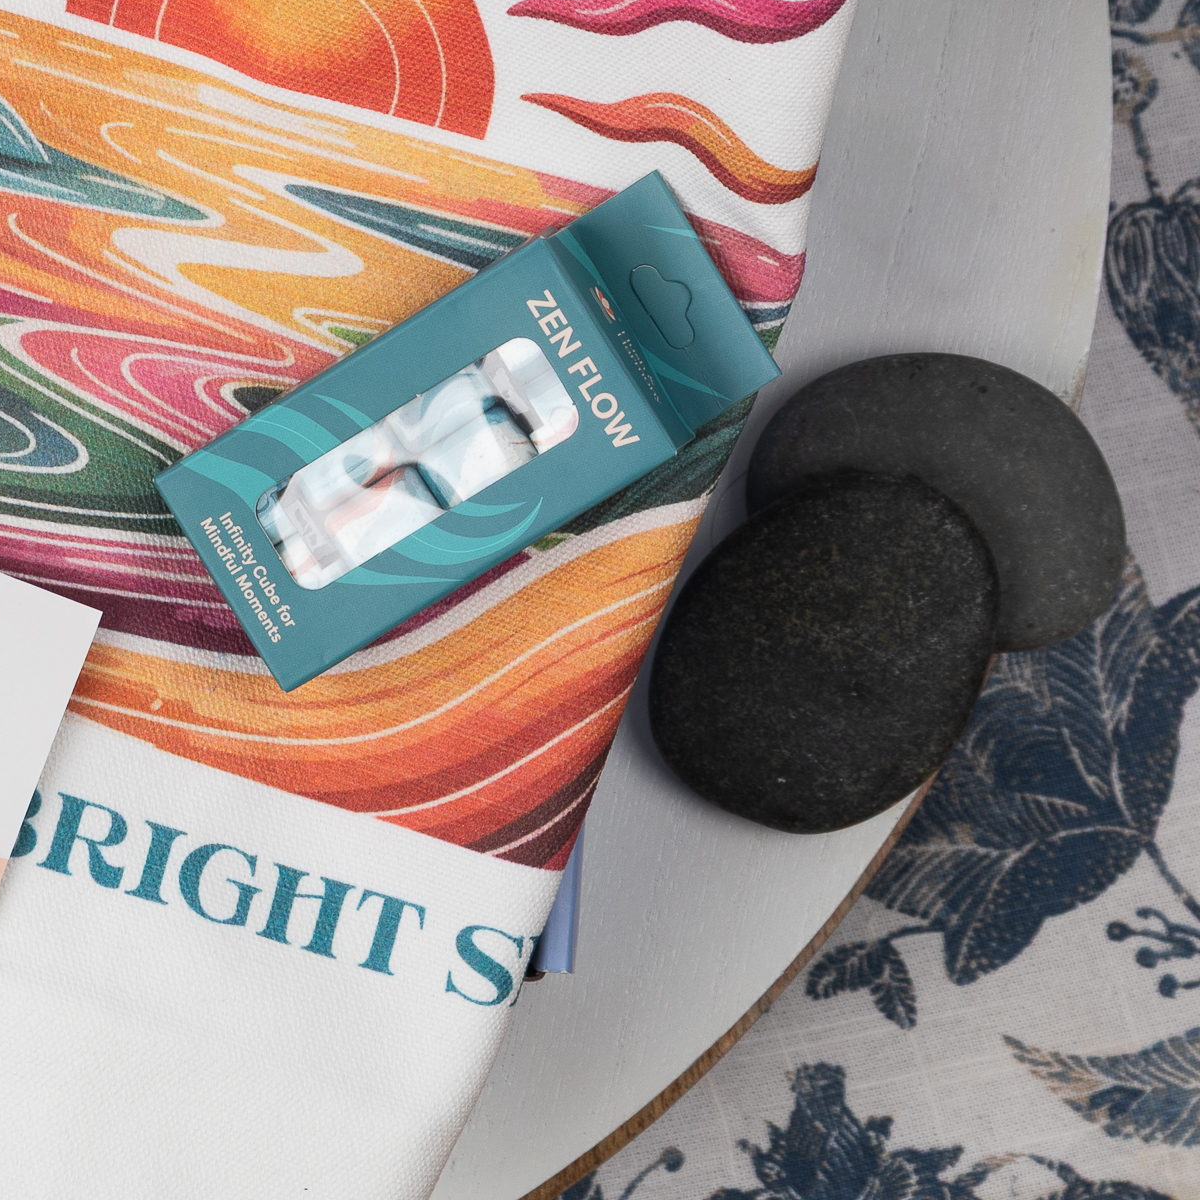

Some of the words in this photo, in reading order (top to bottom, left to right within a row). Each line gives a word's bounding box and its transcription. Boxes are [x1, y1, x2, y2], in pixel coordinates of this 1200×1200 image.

[526, 288, 583, 359] ZEN
[567, 356, 641, 448] FLOW
[200, 517, 243, 576] Mindful
[235, 573, 282, 643] Moments
[219, 511, 257, 566] Infinity
[253, 565, 280, 605] Cube
[276, 604, 296, 627] for
[445, 925, 541, 1007] S
